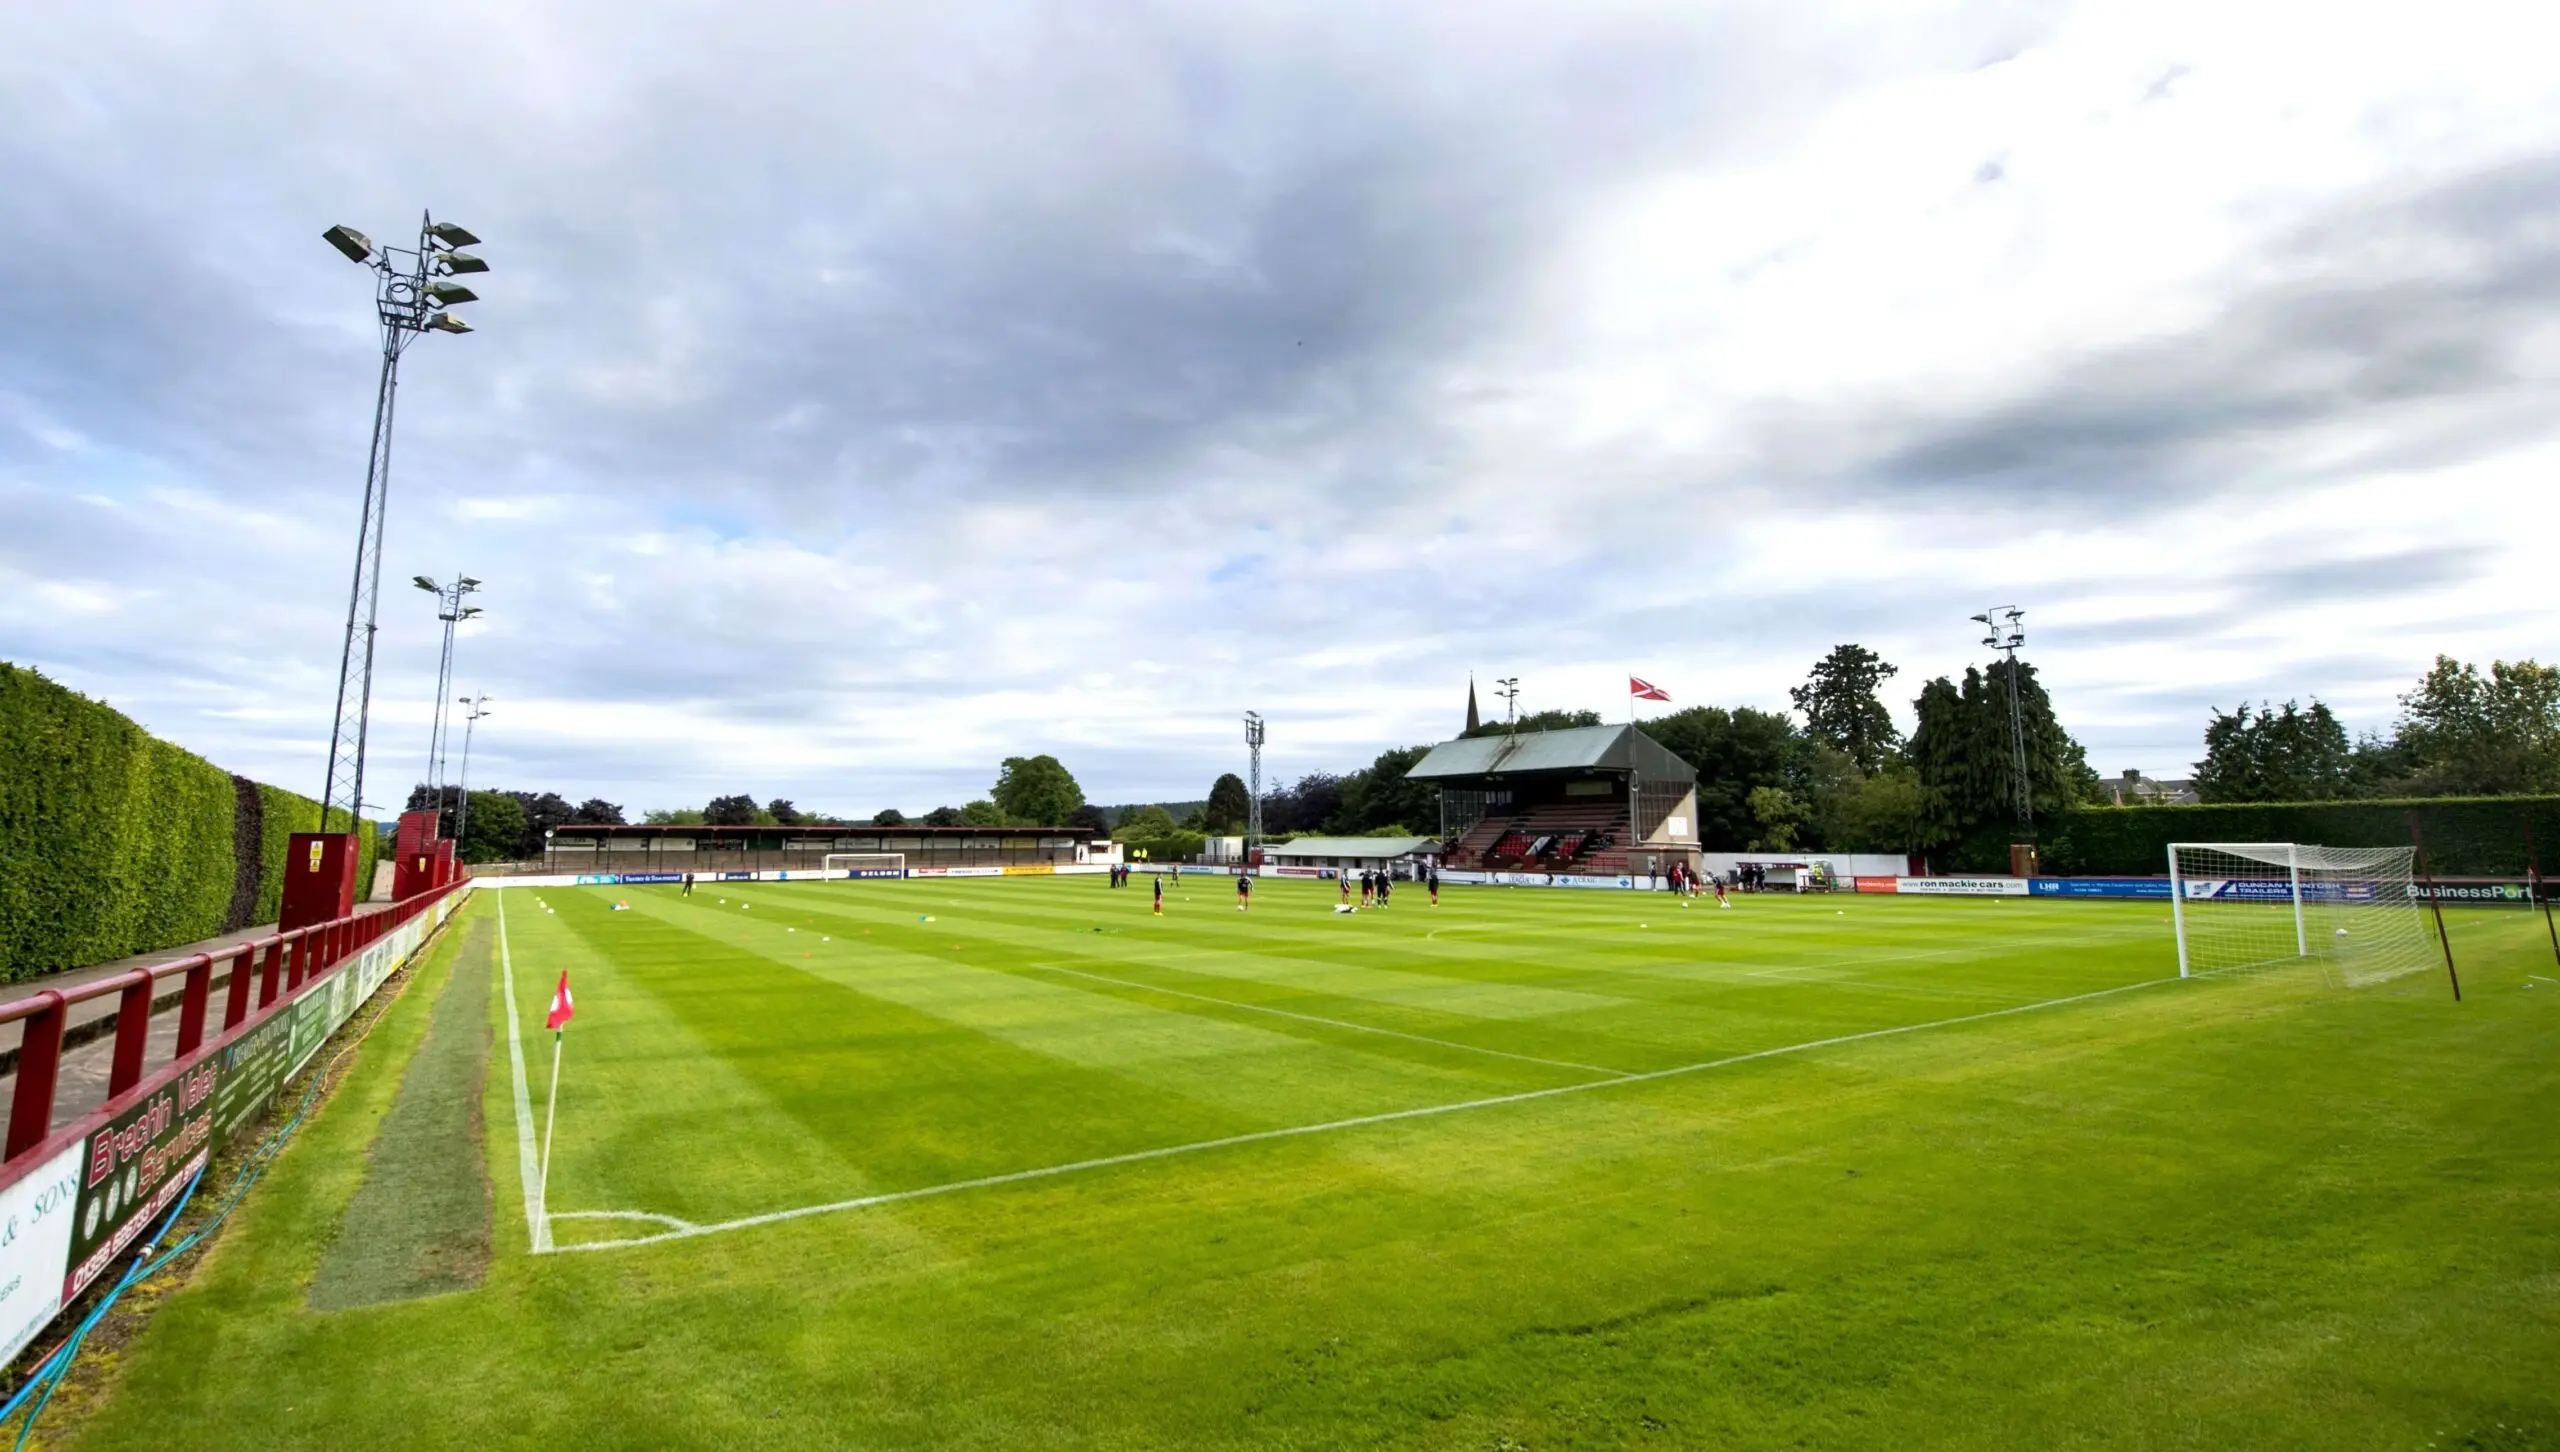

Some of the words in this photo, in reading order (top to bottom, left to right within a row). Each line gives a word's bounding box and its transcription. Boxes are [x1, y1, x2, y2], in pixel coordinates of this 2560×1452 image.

[2406, 884, 2533, 898] BusinessPort
[88, 1091, 172, 1189] Brechin
[178, 1061, 218, 1117] Valet
[138, 1108, 212, 1198] Services
[2, 1216, 19, 1248] &
[32, 1169, 79, 1224] SONS
